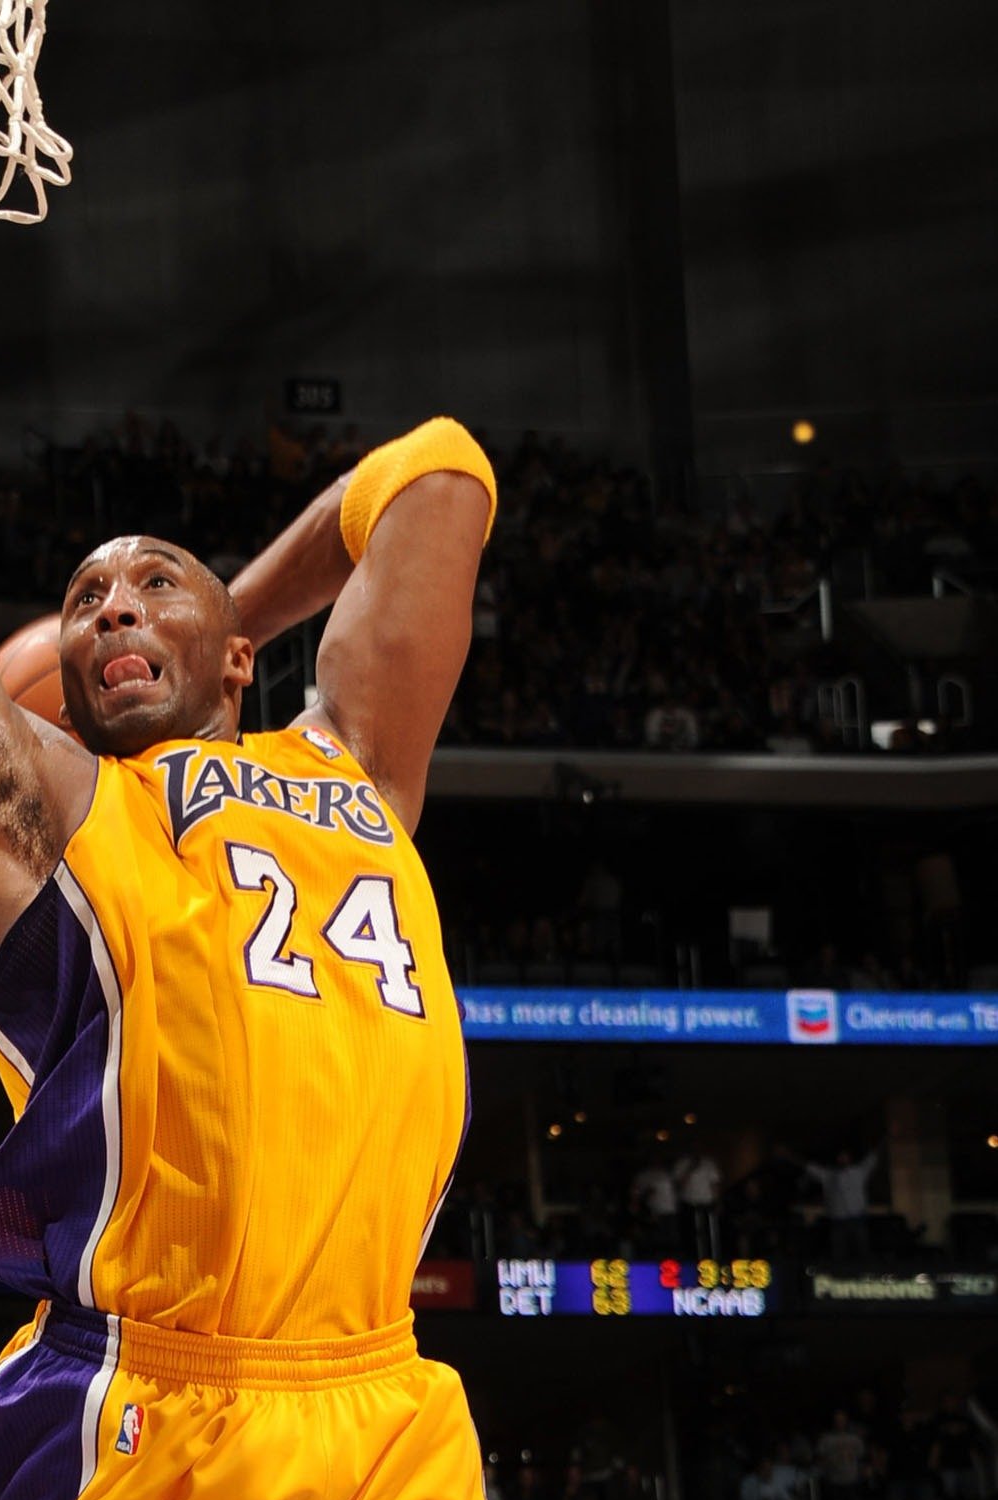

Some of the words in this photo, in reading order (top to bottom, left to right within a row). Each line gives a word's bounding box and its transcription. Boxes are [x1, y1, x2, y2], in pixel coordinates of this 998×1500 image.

[154, 747, 395, 853] LAKERS
[223, 839, 427, 1020] 24
[512, 1003, 574, 1025] more
[579, 999, 680, 1033] cleaning
[684, 1003, 762, 1033] power.
[846, 1002, 936, 1031] Chevron
[500, 1287, 554, 1316] DET
[673, 1287, 765, 1316] NCAAB
